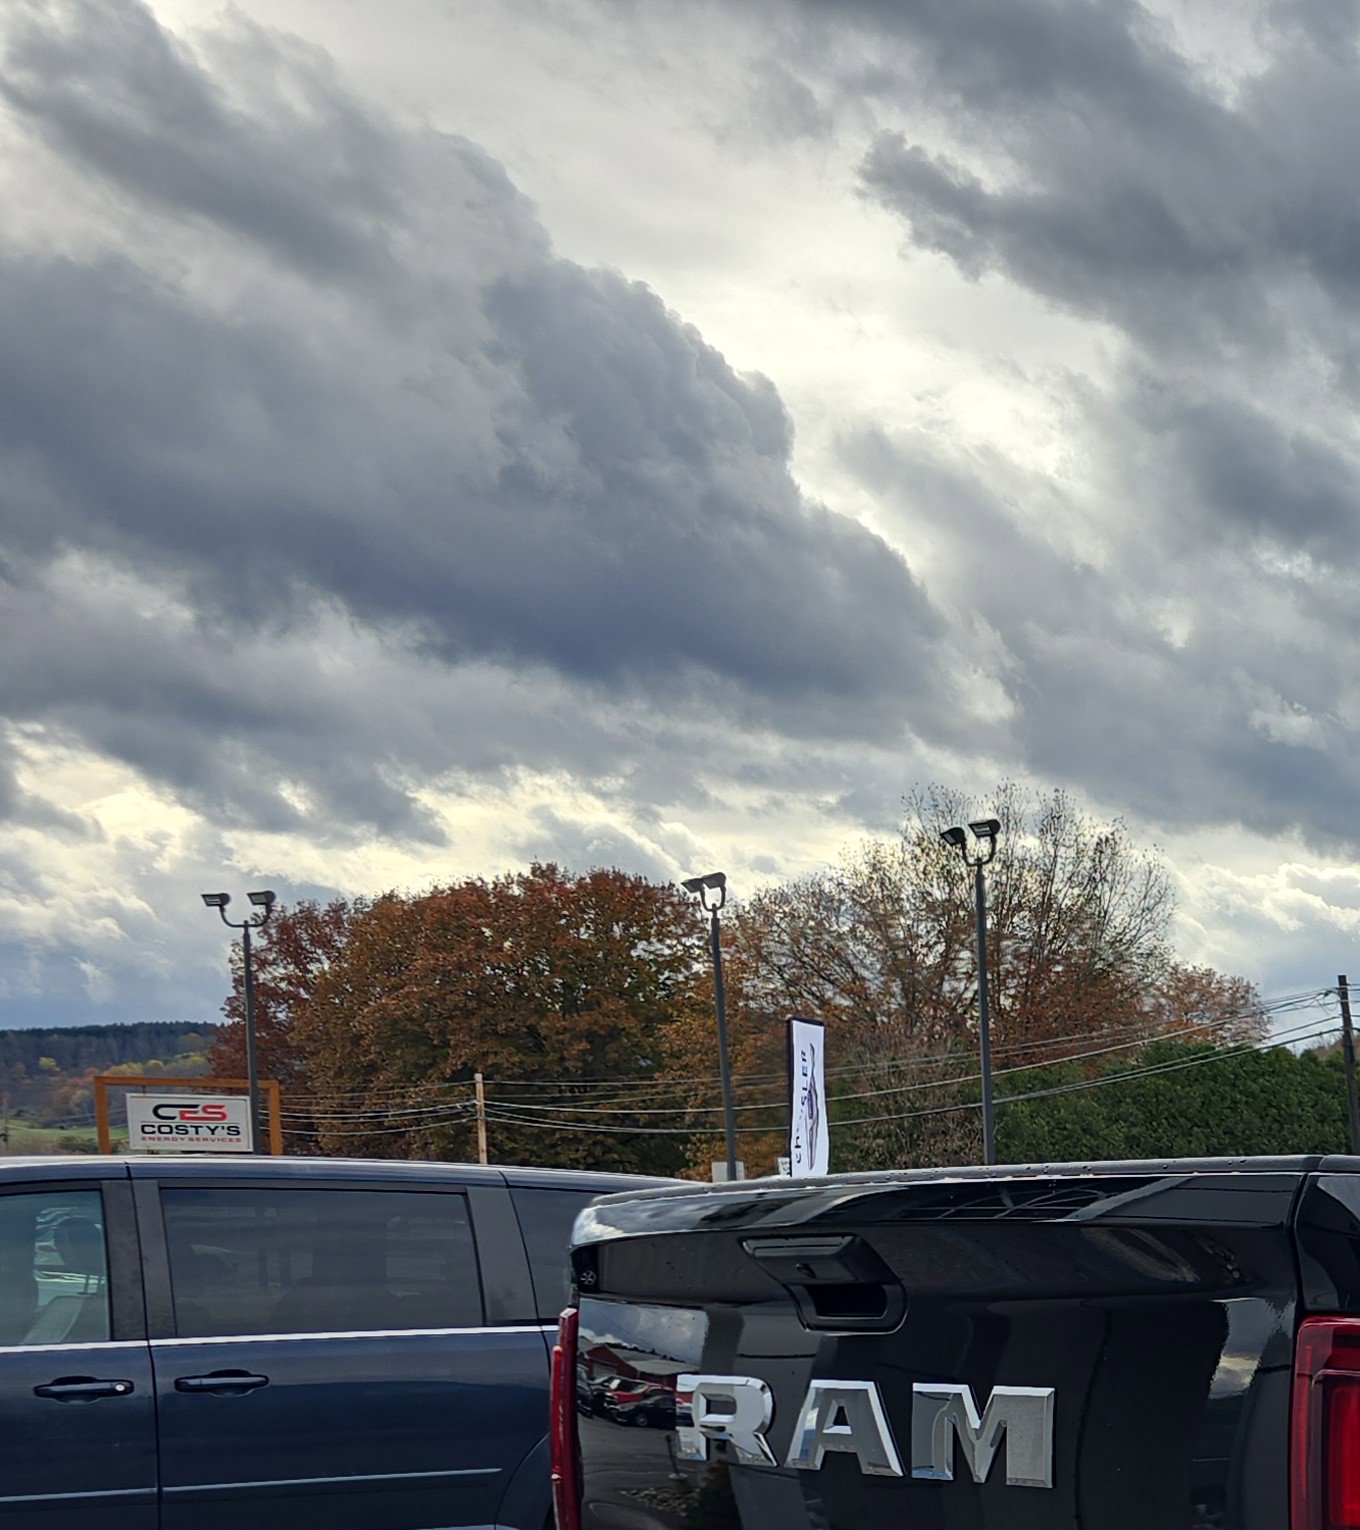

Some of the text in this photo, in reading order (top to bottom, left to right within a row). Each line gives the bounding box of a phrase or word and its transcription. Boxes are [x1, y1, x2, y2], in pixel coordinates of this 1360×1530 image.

[152, 1103, 228, 1122] CES
[140, 1123, 242, 1136] COSTY'S
[675, 1373, 1056, 1489] RAM
